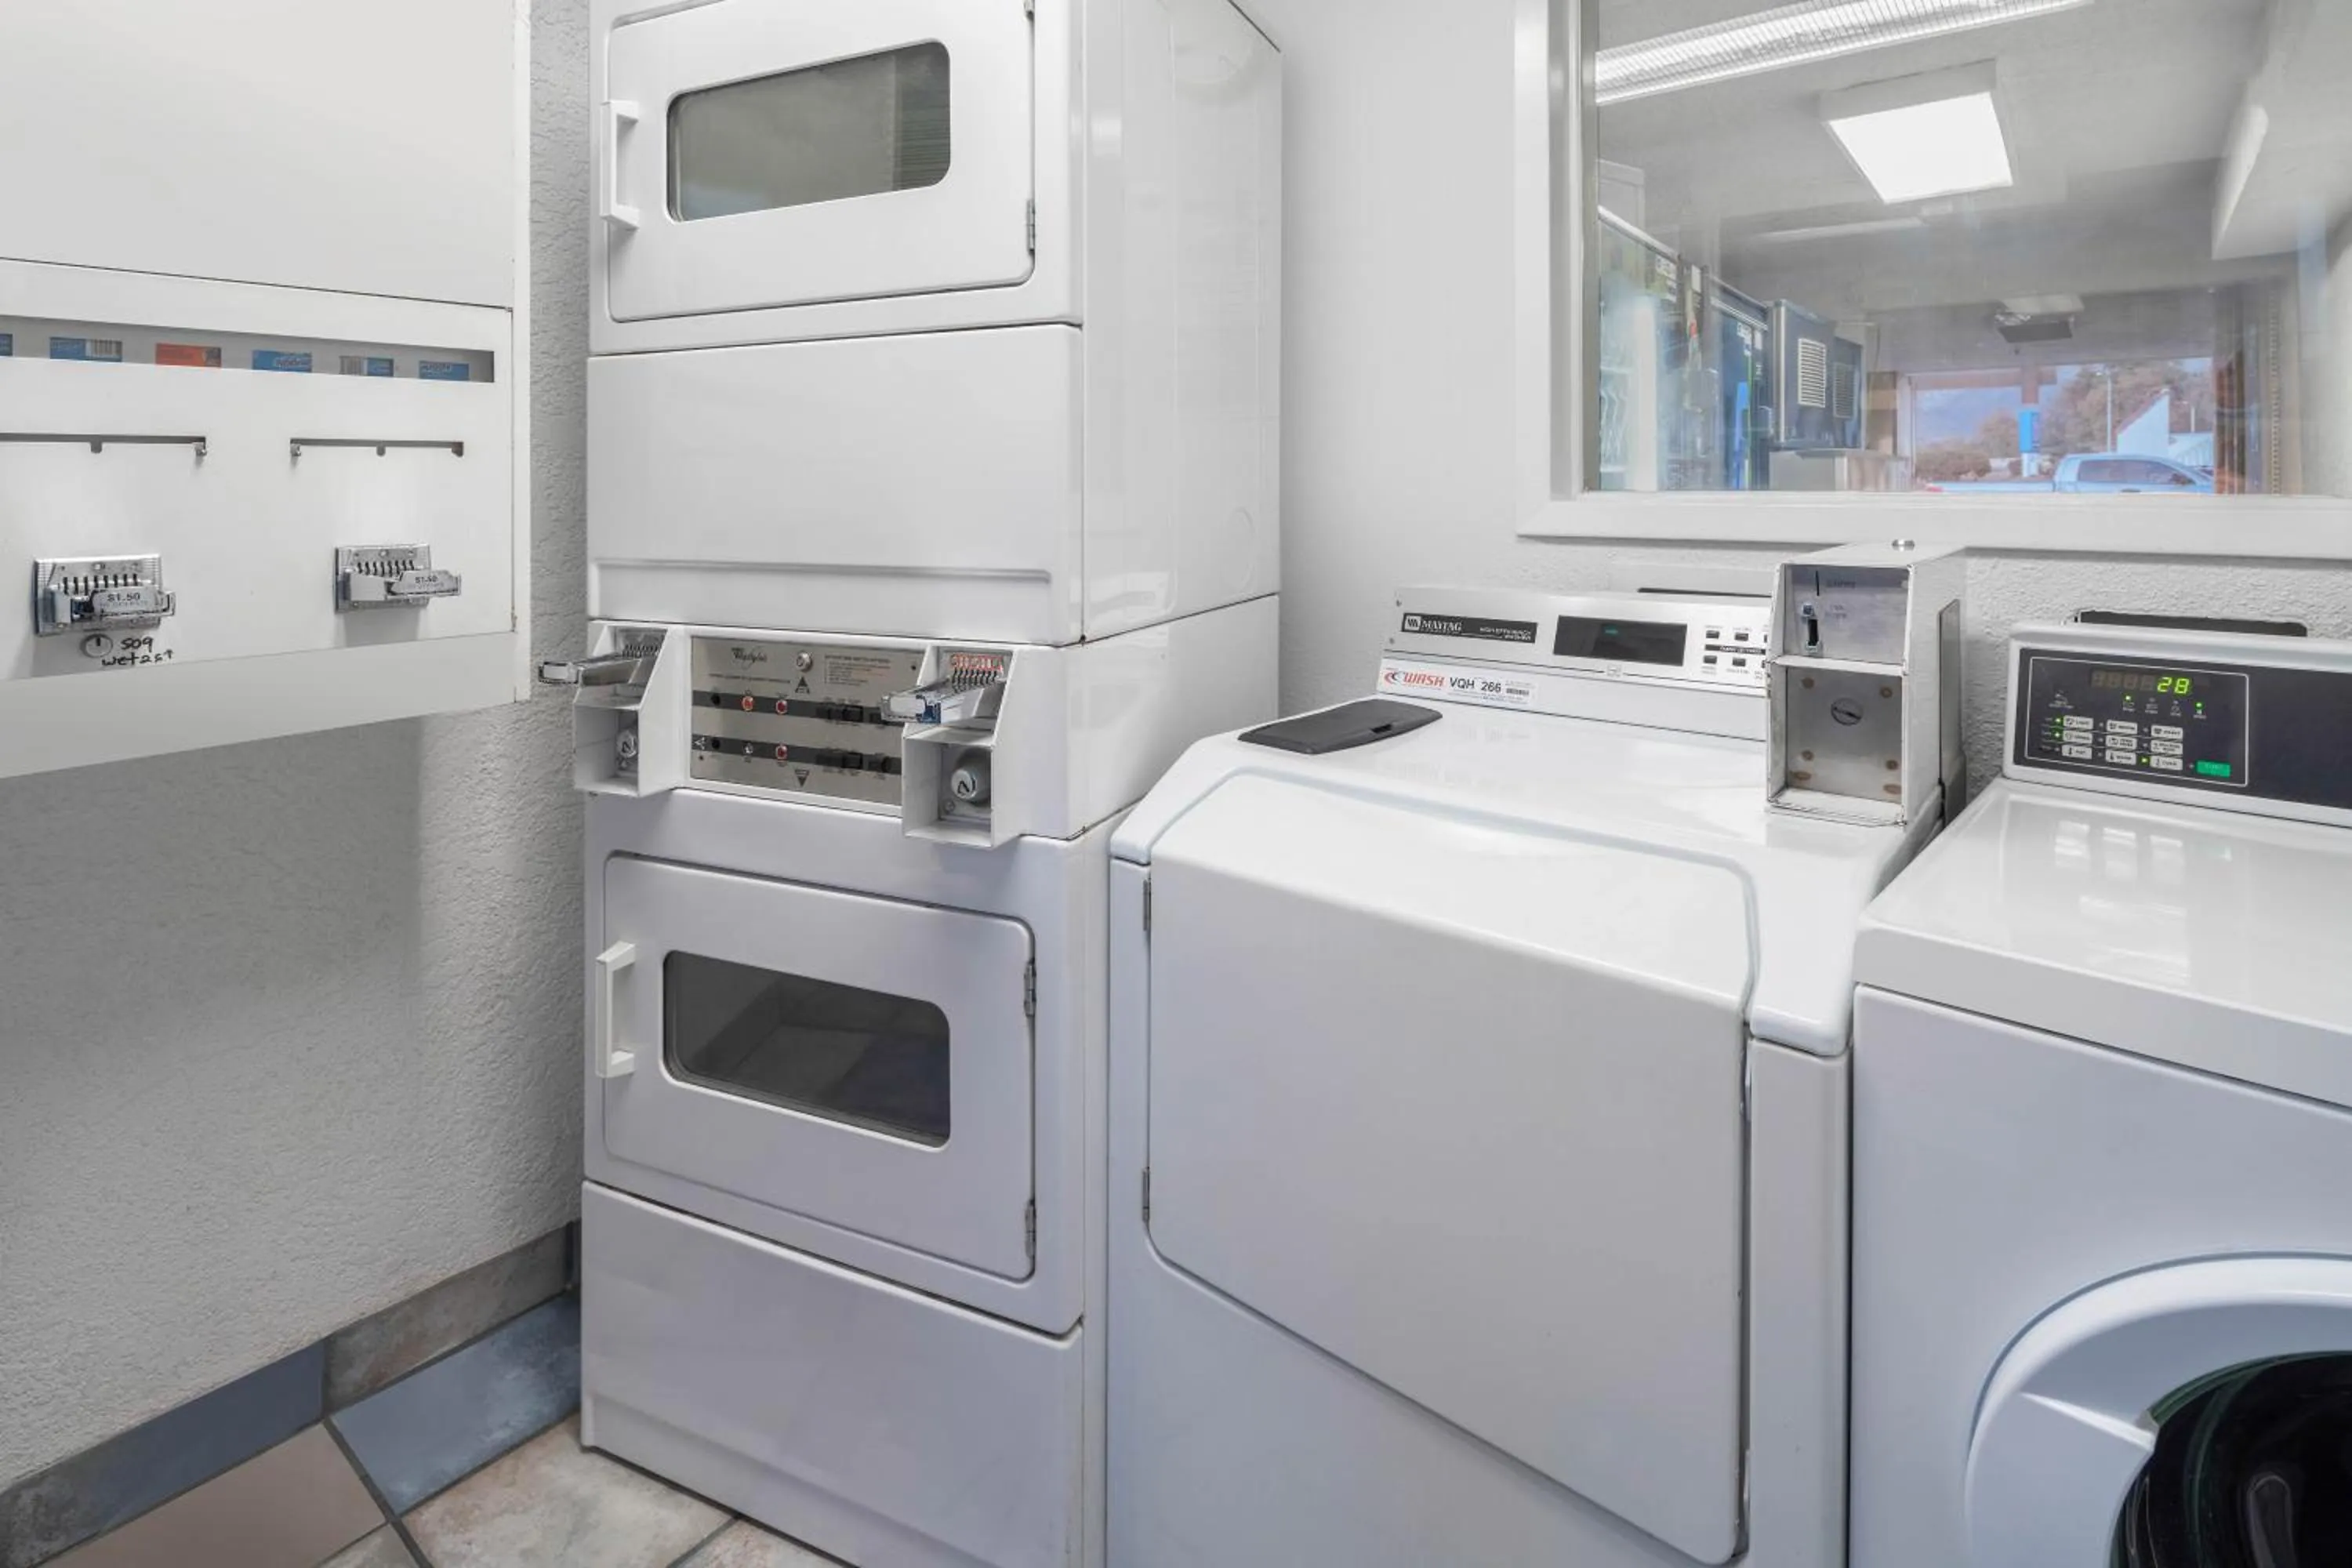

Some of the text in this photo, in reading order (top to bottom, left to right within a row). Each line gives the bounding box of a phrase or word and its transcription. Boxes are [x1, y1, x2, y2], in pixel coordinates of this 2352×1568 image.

[1421, 619, 1462, 632] MAYTAG
[1403, 672, 1446, 687] WASH
[1450, 677, 1475, 689] VQH
[2157, 677, 2190, 694] 28
